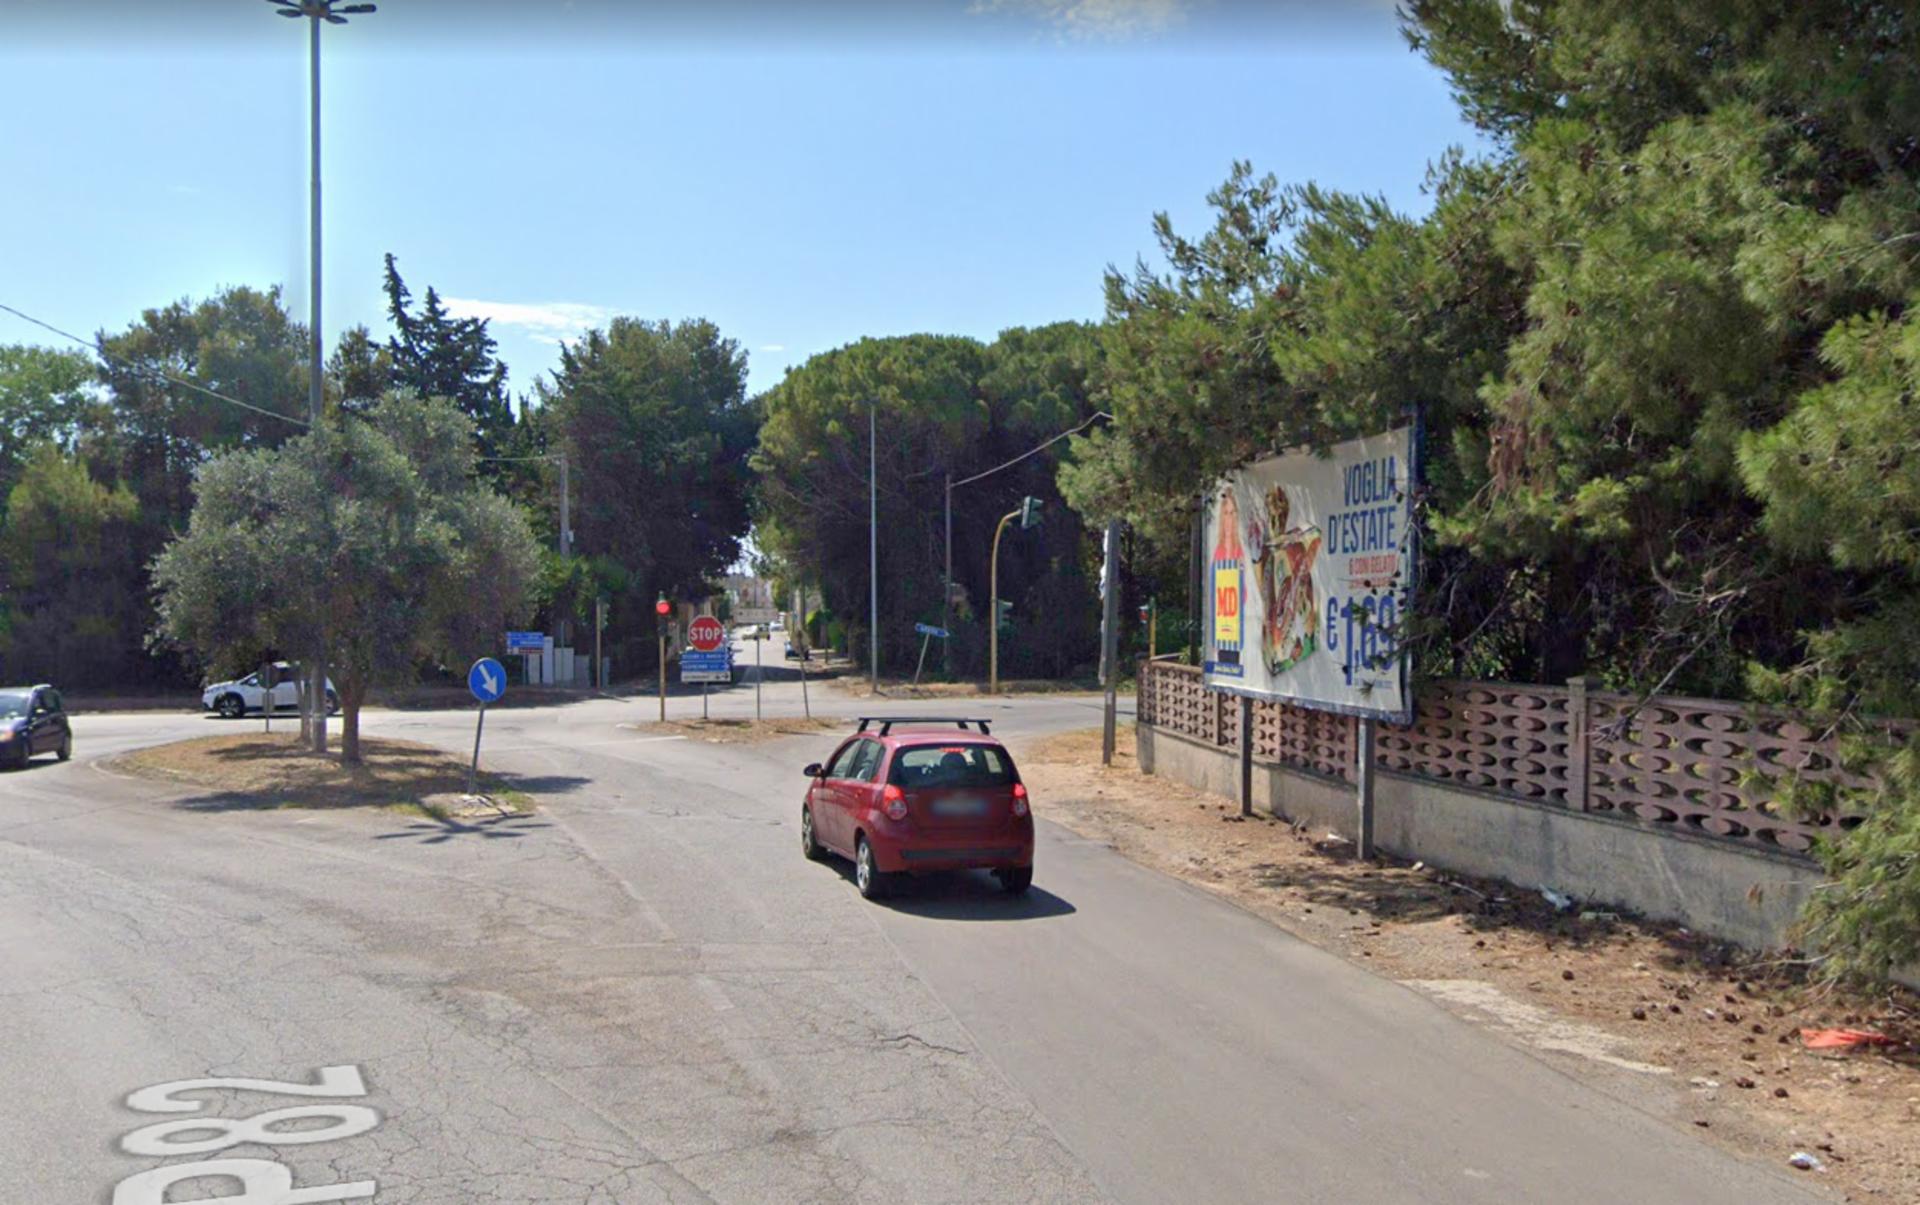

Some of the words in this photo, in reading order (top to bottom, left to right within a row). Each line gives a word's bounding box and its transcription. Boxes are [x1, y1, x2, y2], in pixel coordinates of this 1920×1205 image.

[1343, 456, 1396, 507] VOGLIA
[1328, 505, 1396, 554] D'ESTATE
[690, 627, 721, 641] STOP
